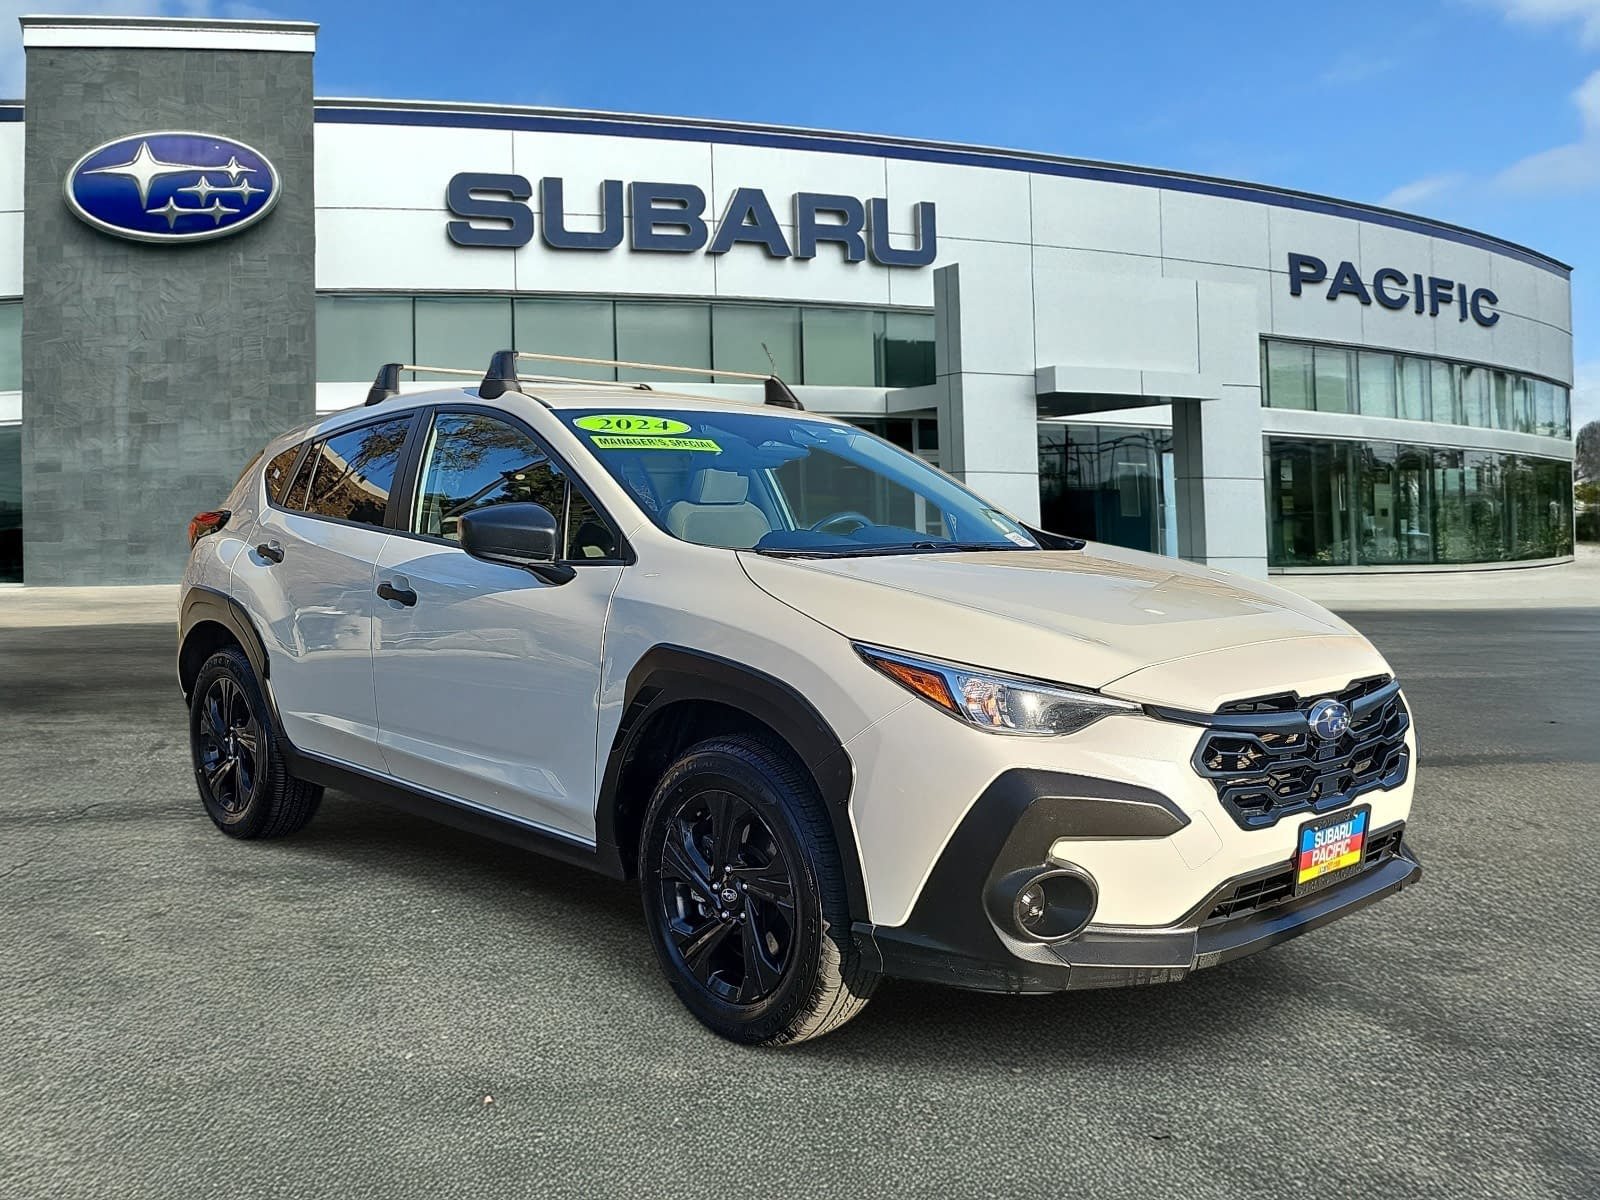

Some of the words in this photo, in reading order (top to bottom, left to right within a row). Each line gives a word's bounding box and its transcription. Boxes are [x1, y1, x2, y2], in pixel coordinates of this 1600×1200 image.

[446, 171, 937, 268] SUBARU
[1288, 252, 1500, 327] PACIFIC
[598, 418, 670, 431] 2024
[599, 437, 667, 447] MANAGER'S
[670, 439, 716, 449] SPECIAL
[1314, 821, 1353, 848] SUBARU
[1311, 839, 1351, 866] PACIFIC
